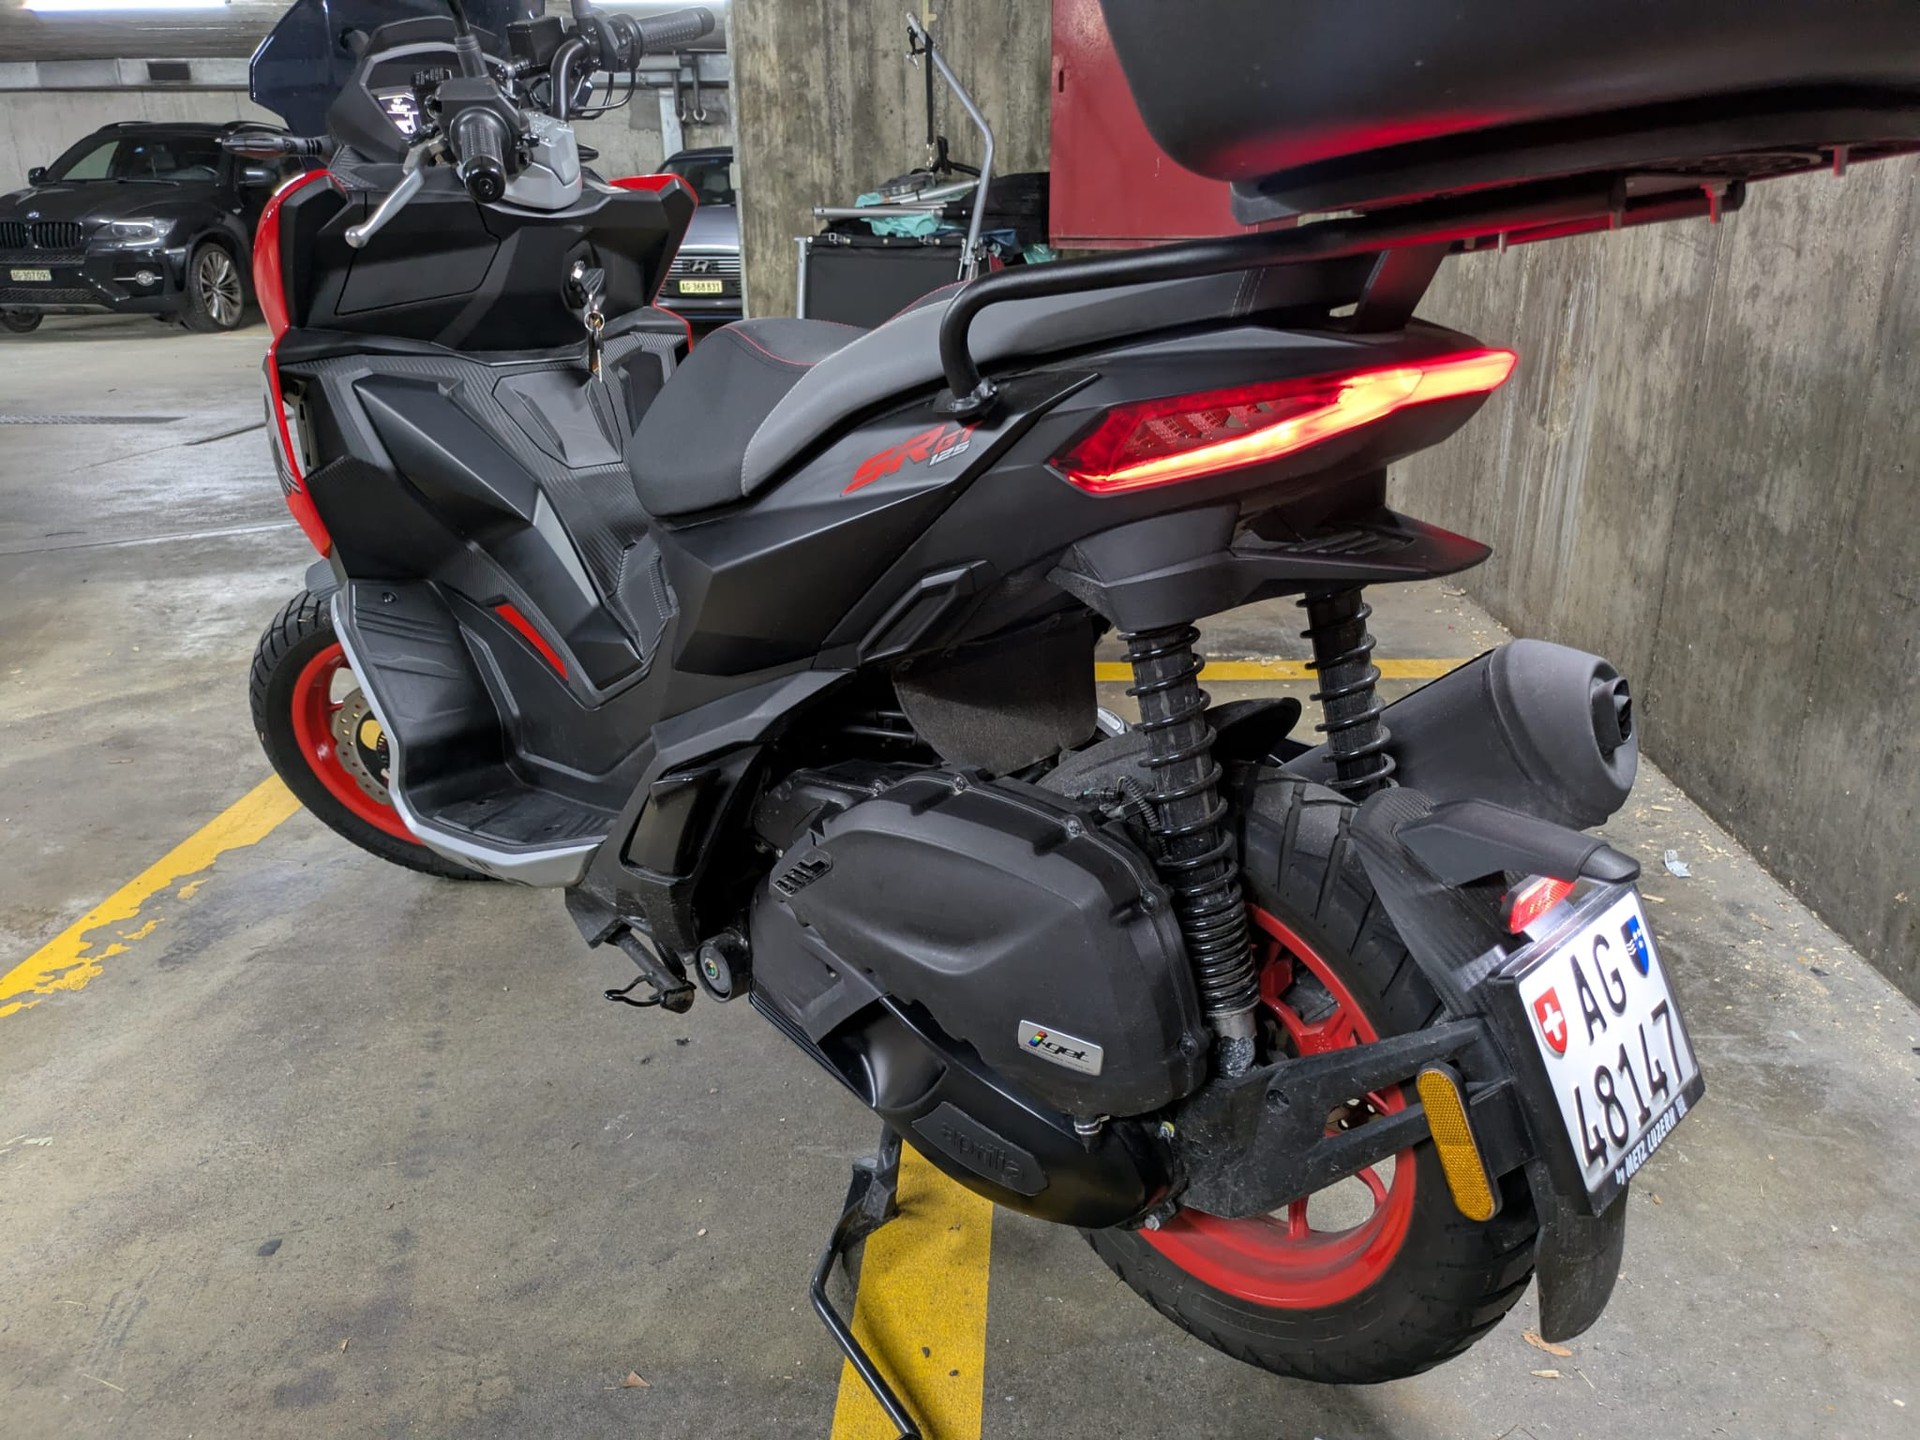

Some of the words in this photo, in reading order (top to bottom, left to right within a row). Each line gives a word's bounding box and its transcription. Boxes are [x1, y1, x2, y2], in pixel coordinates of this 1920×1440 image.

[928, 441, 971, 467] 125
[1570, 934, 1627, 1045] AG
[1573, 998, 1684, 1170] 48147
[1624, 1139, 1649, 1179] METZ
[1646, 1106, 1677, 1154] LUZERN
